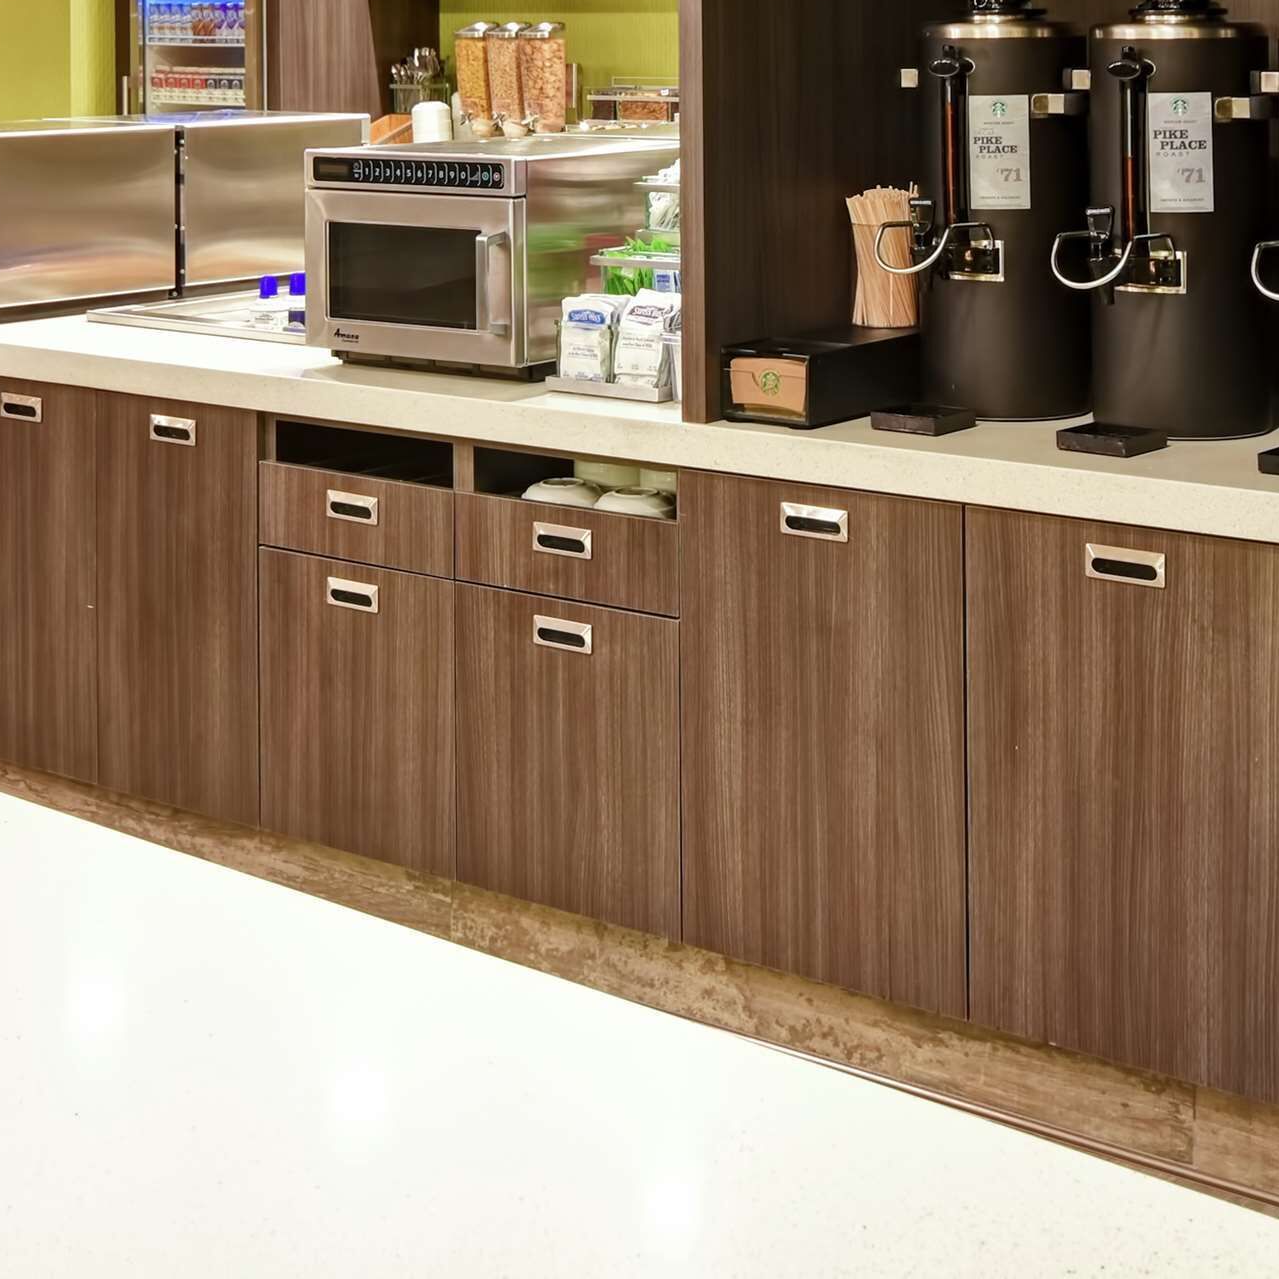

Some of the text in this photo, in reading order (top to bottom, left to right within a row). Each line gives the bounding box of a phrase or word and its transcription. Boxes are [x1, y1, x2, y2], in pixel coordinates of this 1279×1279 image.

[1153, 129, 1188, 139] PIKE
[973, 136, 1002, 145] PIKE
[1160, 140, 1207, 150] PLACE
[979, 145, 1018, 154] PLACE
[364, 167, 466, 180] 1 2 3 4 5 6 7 8 9 0
